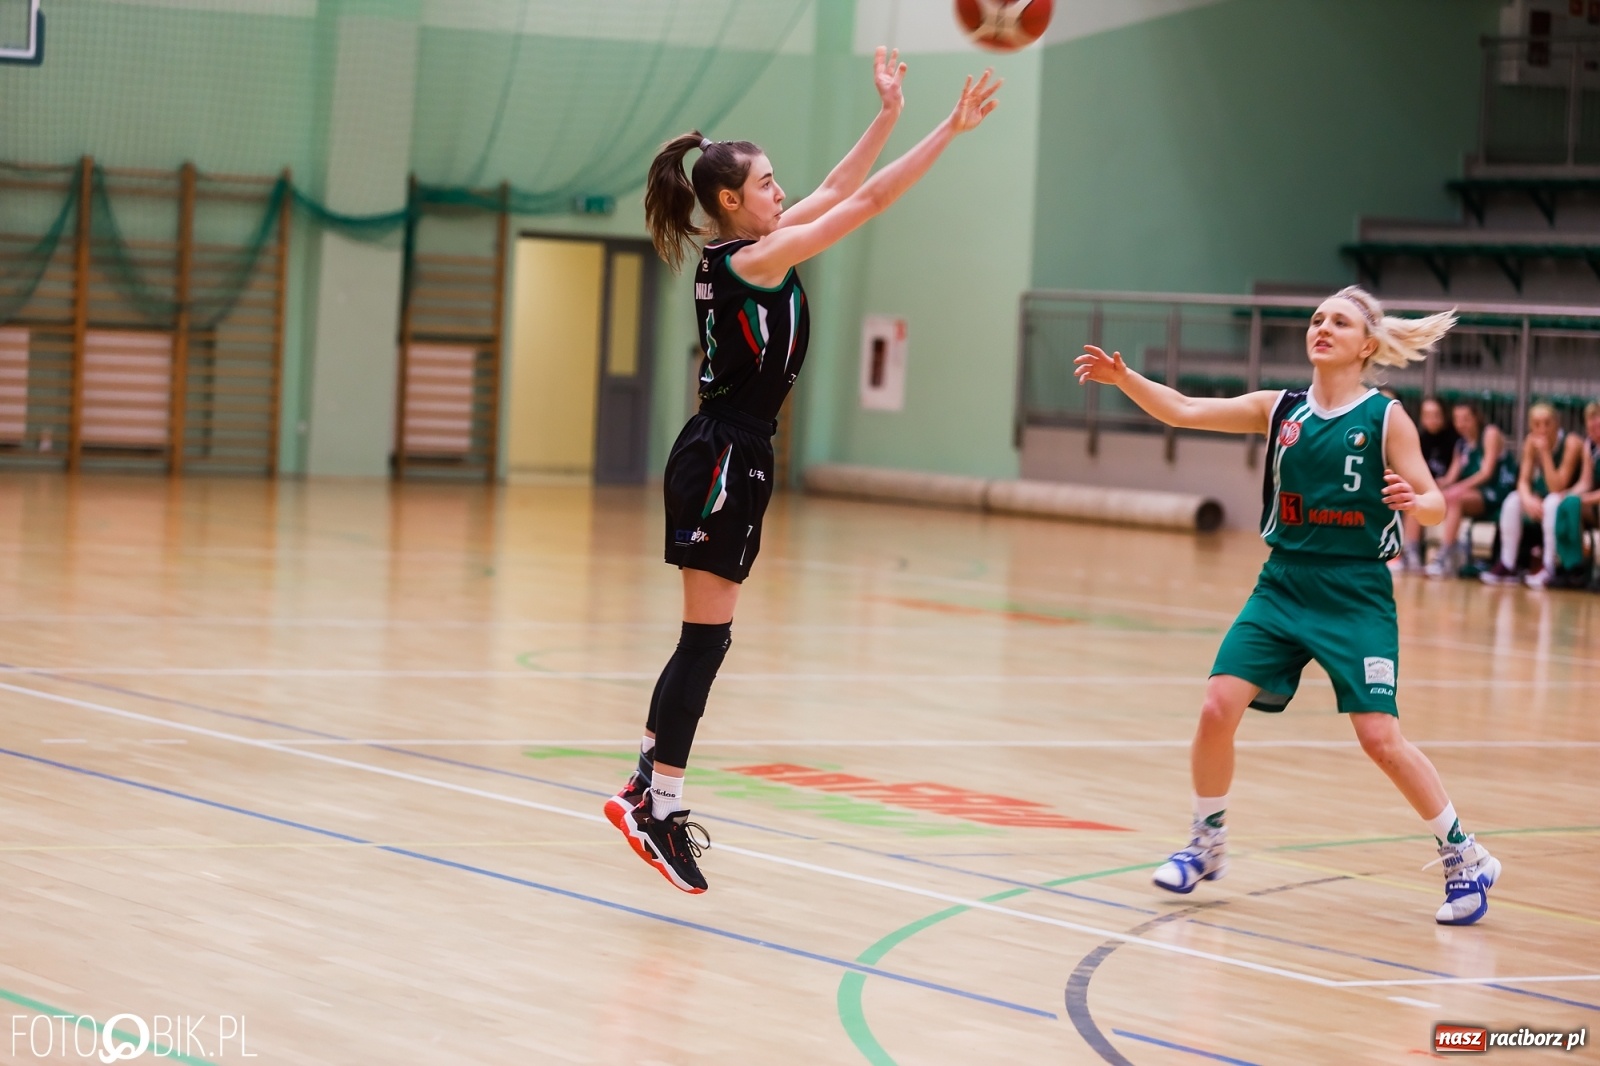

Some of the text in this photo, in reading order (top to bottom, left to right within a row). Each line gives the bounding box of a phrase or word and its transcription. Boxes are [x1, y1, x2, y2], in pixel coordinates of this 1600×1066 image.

[1342, 454, 1364, 493] 5
[1281, 496, 1366, 527] K KAMAN
